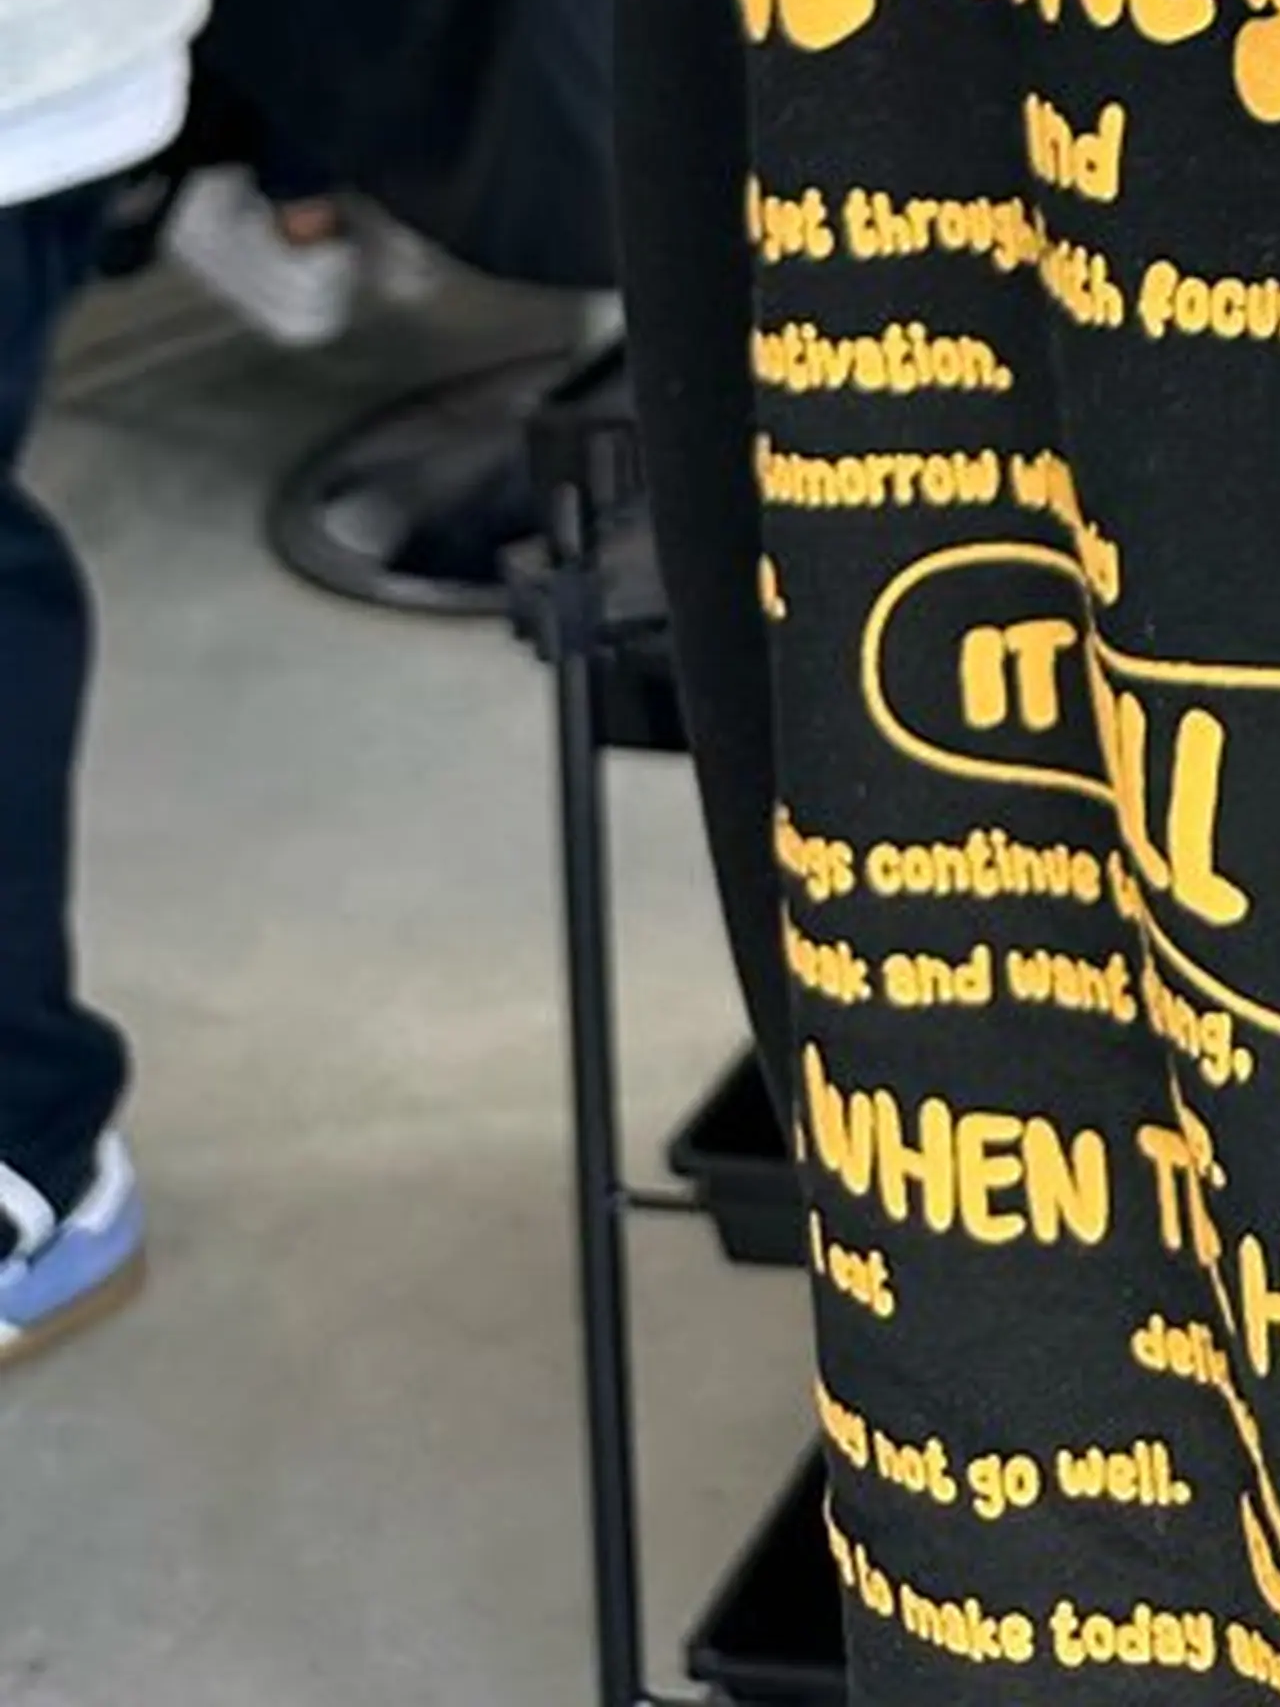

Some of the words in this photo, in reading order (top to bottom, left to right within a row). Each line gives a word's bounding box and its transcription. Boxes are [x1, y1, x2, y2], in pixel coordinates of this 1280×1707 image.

[960, 620, 1076, 730] IT
[866, 830, 1100, 902] continue
[882, 945, 992, 1007] and
[1006, 950, 1136, 1023] want
[803, 1042, 1109, 1247] WHEN
[874, 1431, 957, 1503] not
[967, 1455, 1040, 1519] go
[1057, 1441, 1191, 1506] well.
[900, 1585, 1034, 1663] make
[1049, 1601, 1216, 1672] today
